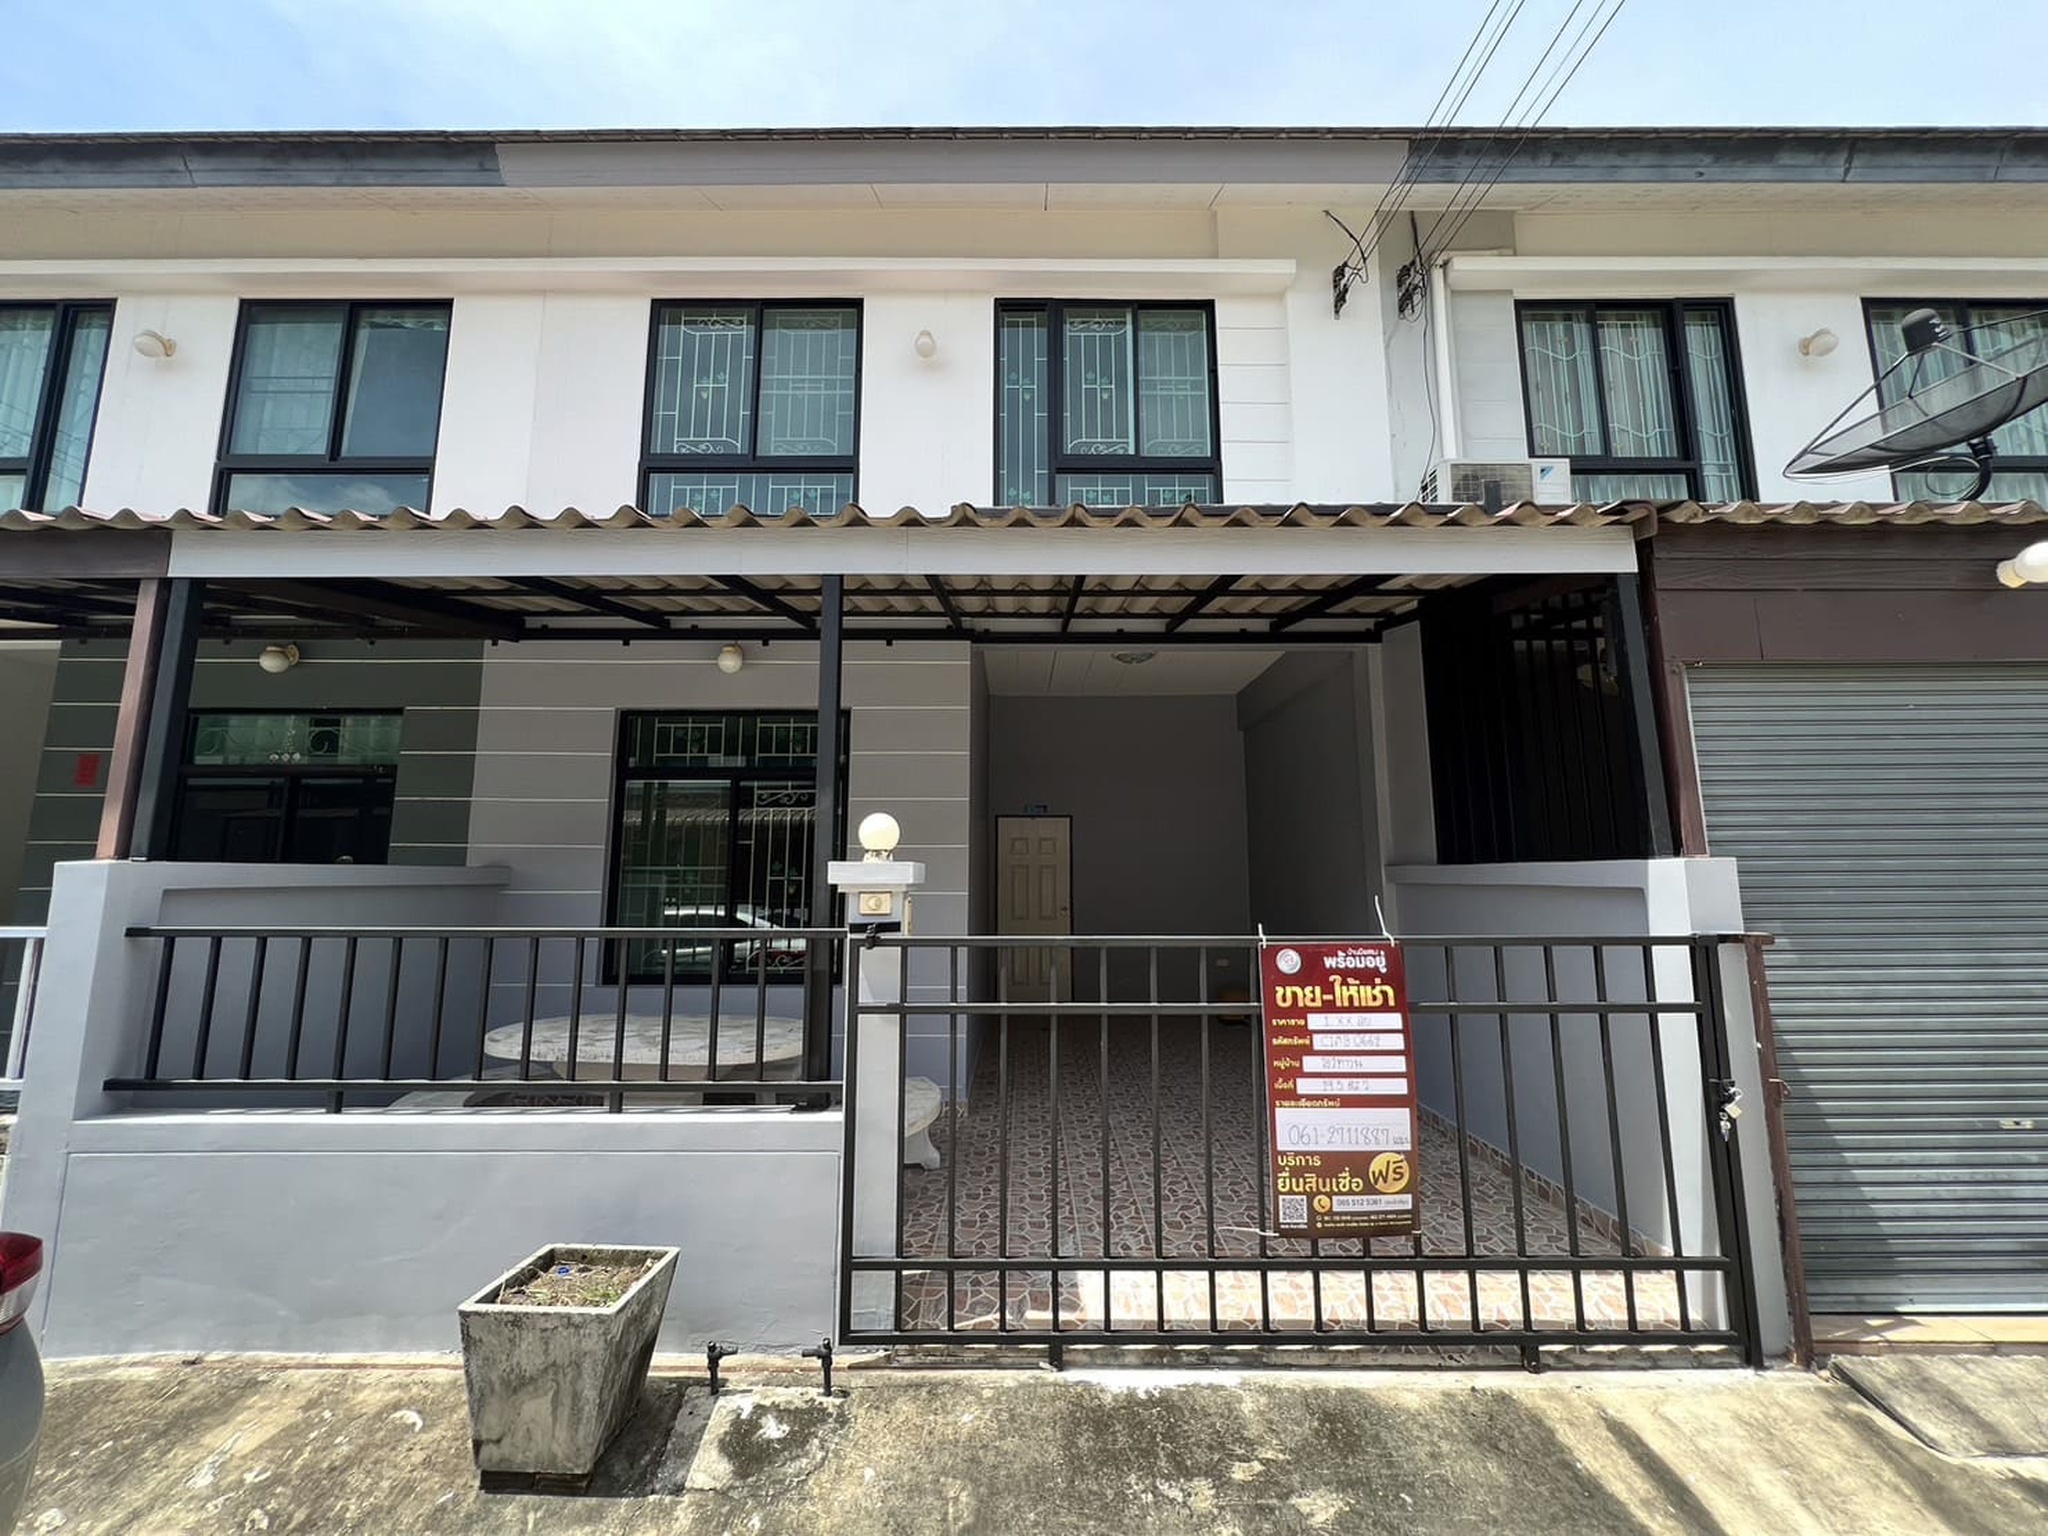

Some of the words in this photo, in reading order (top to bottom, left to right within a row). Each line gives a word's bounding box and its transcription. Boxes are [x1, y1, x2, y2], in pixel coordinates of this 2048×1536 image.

[1324, 950, 1387, 973] พร้อมอยู่
[1275, 975, 1395, 1007] ขาย-ให้เช่า
[1278, 1152, 1321, 1166] บริการ
[1277, 1167, 1363, 1192] ยื่นสินเชื่อ
[1372, 1160, 1404, 1185] ฟรี
